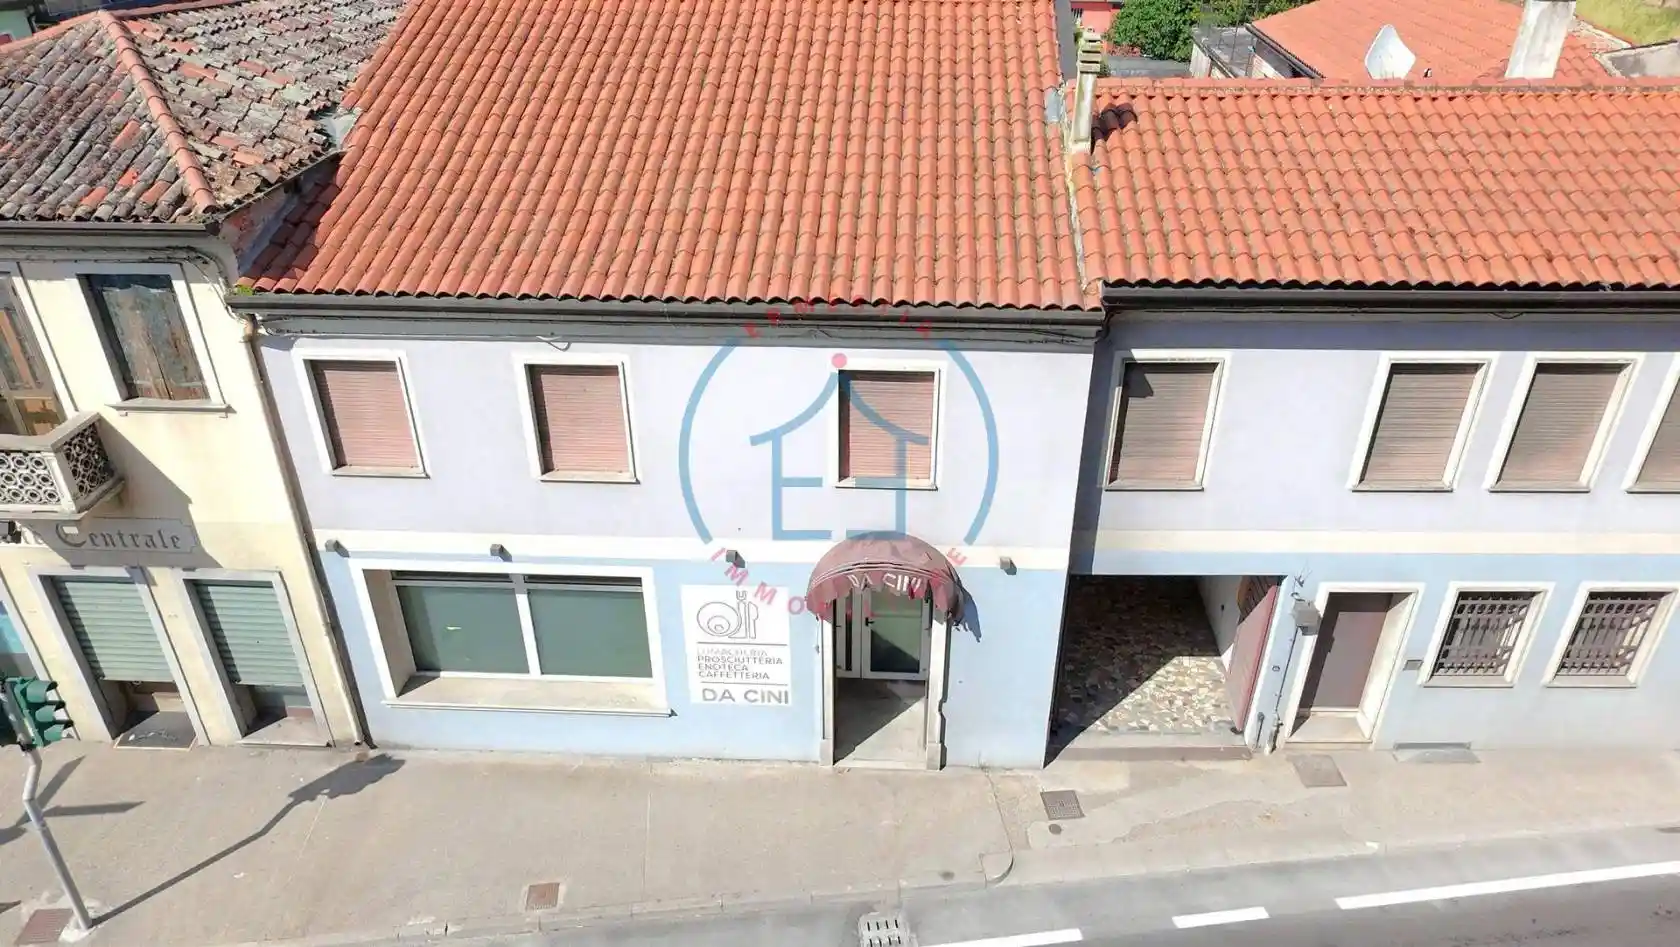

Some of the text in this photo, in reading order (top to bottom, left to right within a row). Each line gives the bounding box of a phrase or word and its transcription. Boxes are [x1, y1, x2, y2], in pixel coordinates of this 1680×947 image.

[55, 522, 182, 550] Centrale
[847, 572, 873, 592] DA
[697, 655, 783, 665] PROSCIUTTERIA
[698, 663, 749, 673] ENOTECA
[699, 670, 770, 680] CAFFETTERIA
[702, 688, 789, 704] DA CINI
